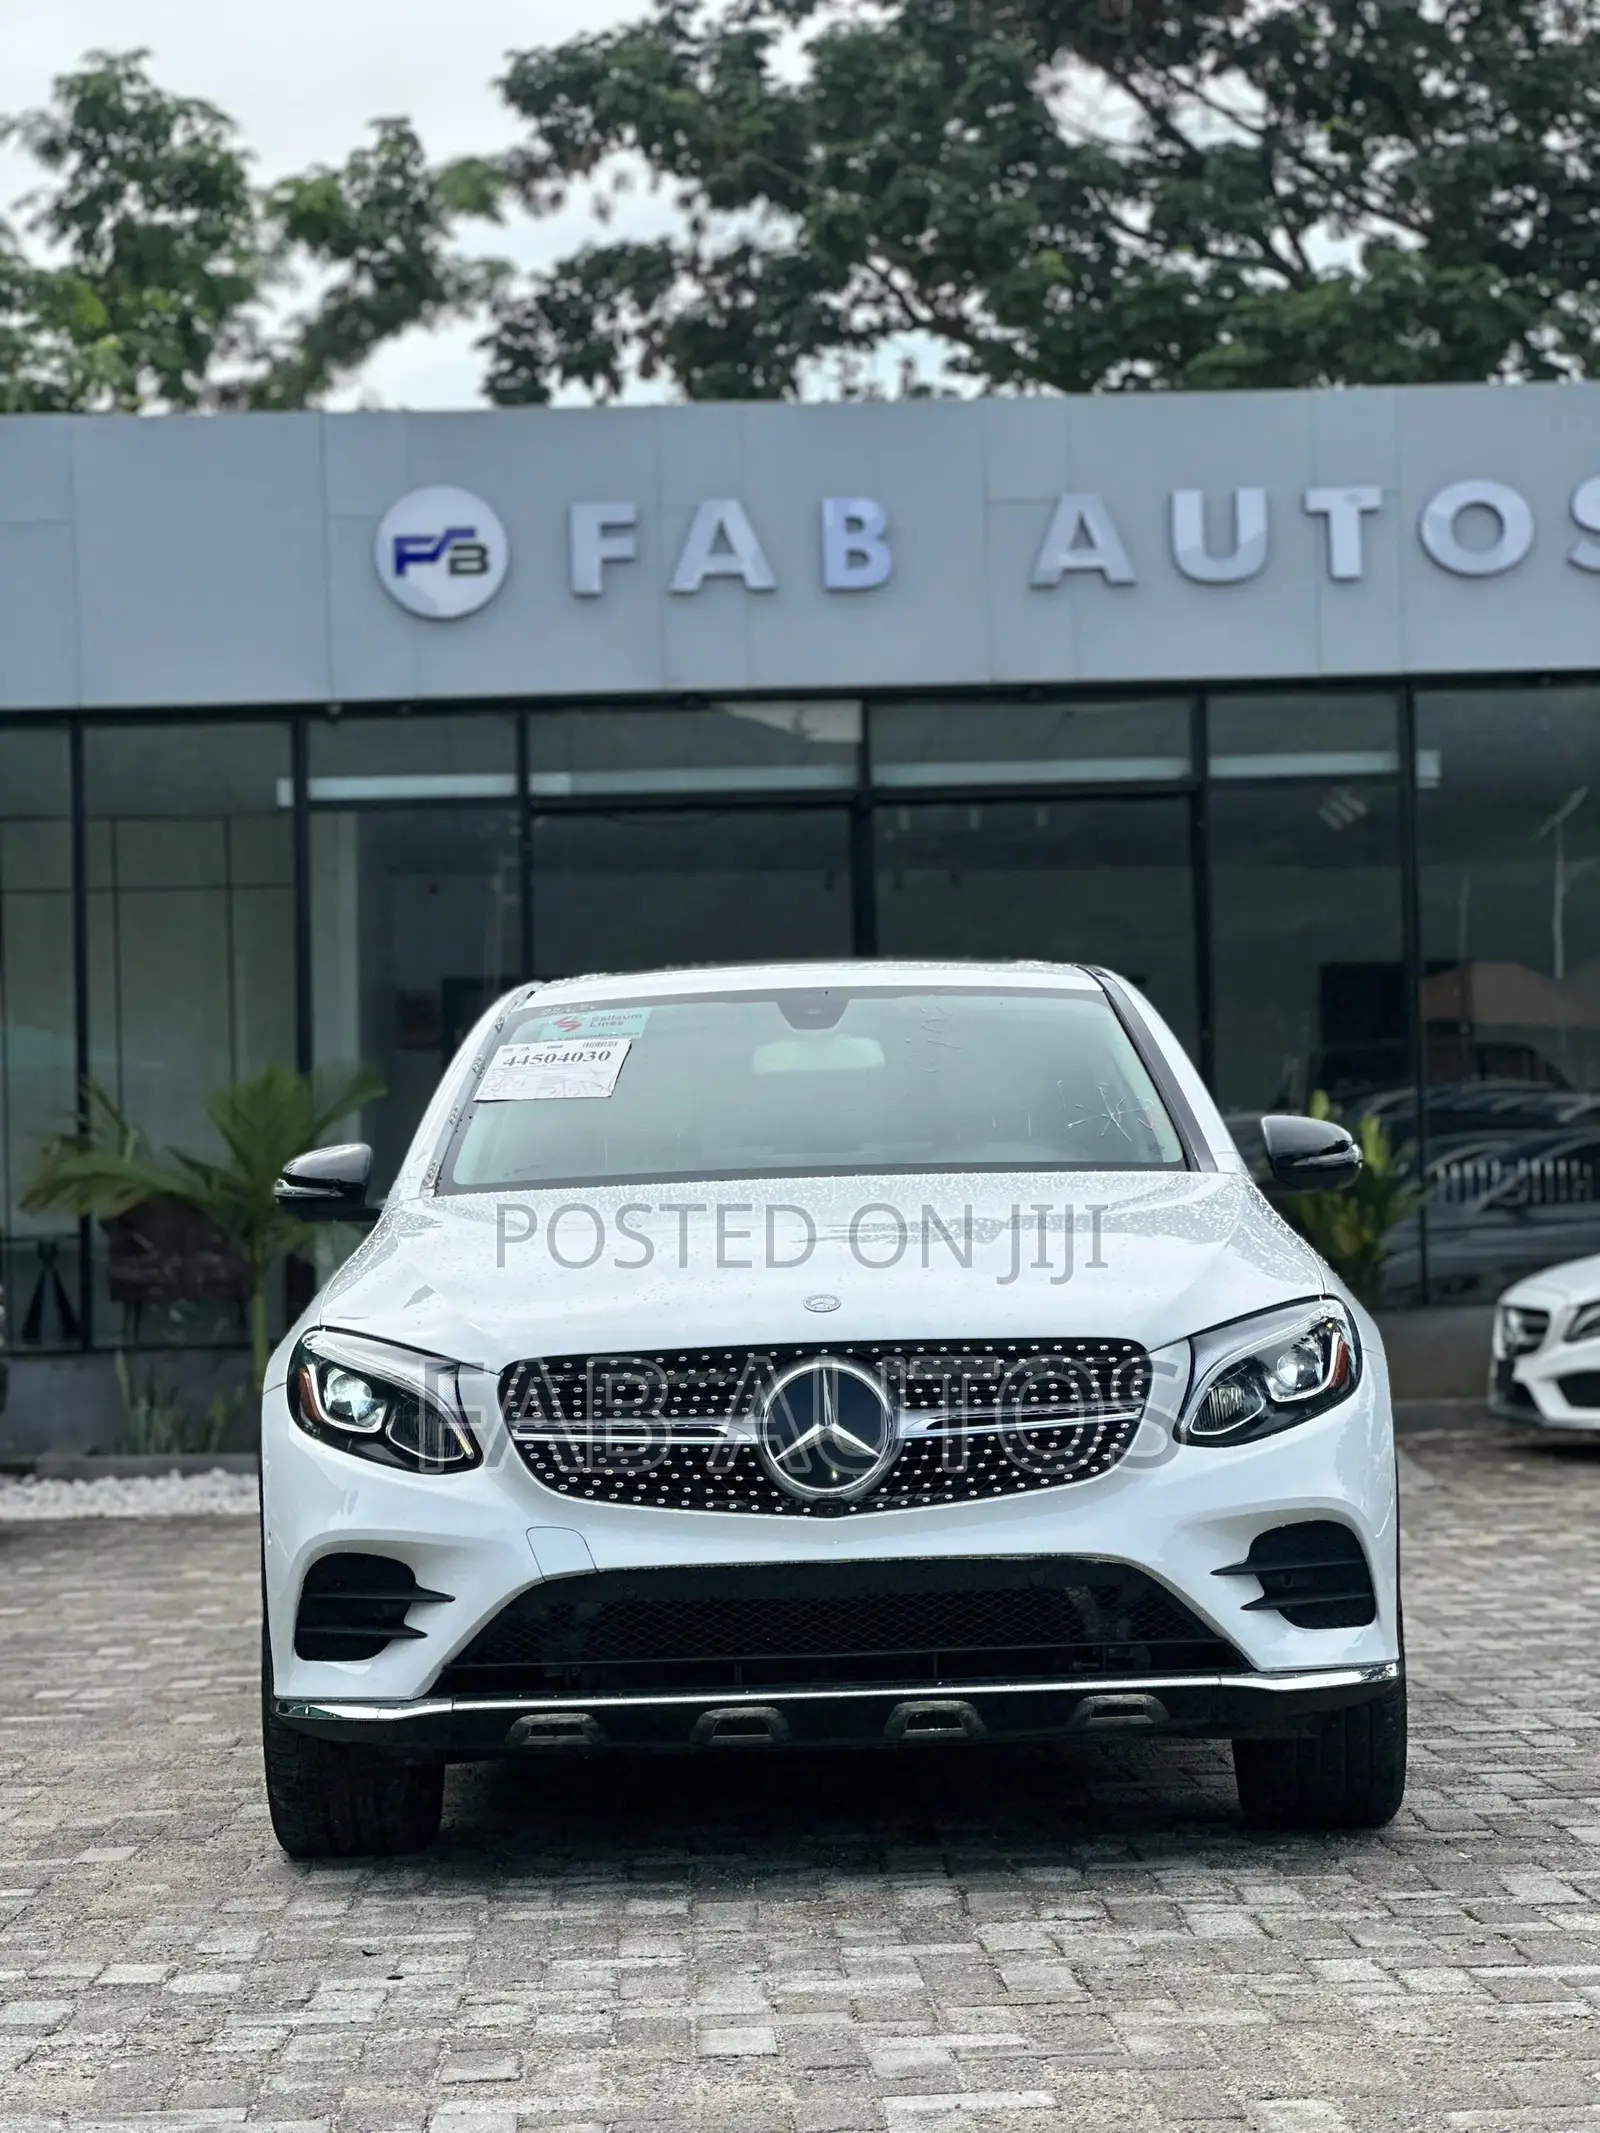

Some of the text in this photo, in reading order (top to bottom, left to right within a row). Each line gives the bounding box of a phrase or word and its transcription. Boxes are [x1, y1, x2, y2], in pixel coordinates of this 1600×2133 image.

[568, 497, 893, 600] FAB
[589, 1020, 625, 1028] Lines
[503, 1050, 612, 1067] 44504030
